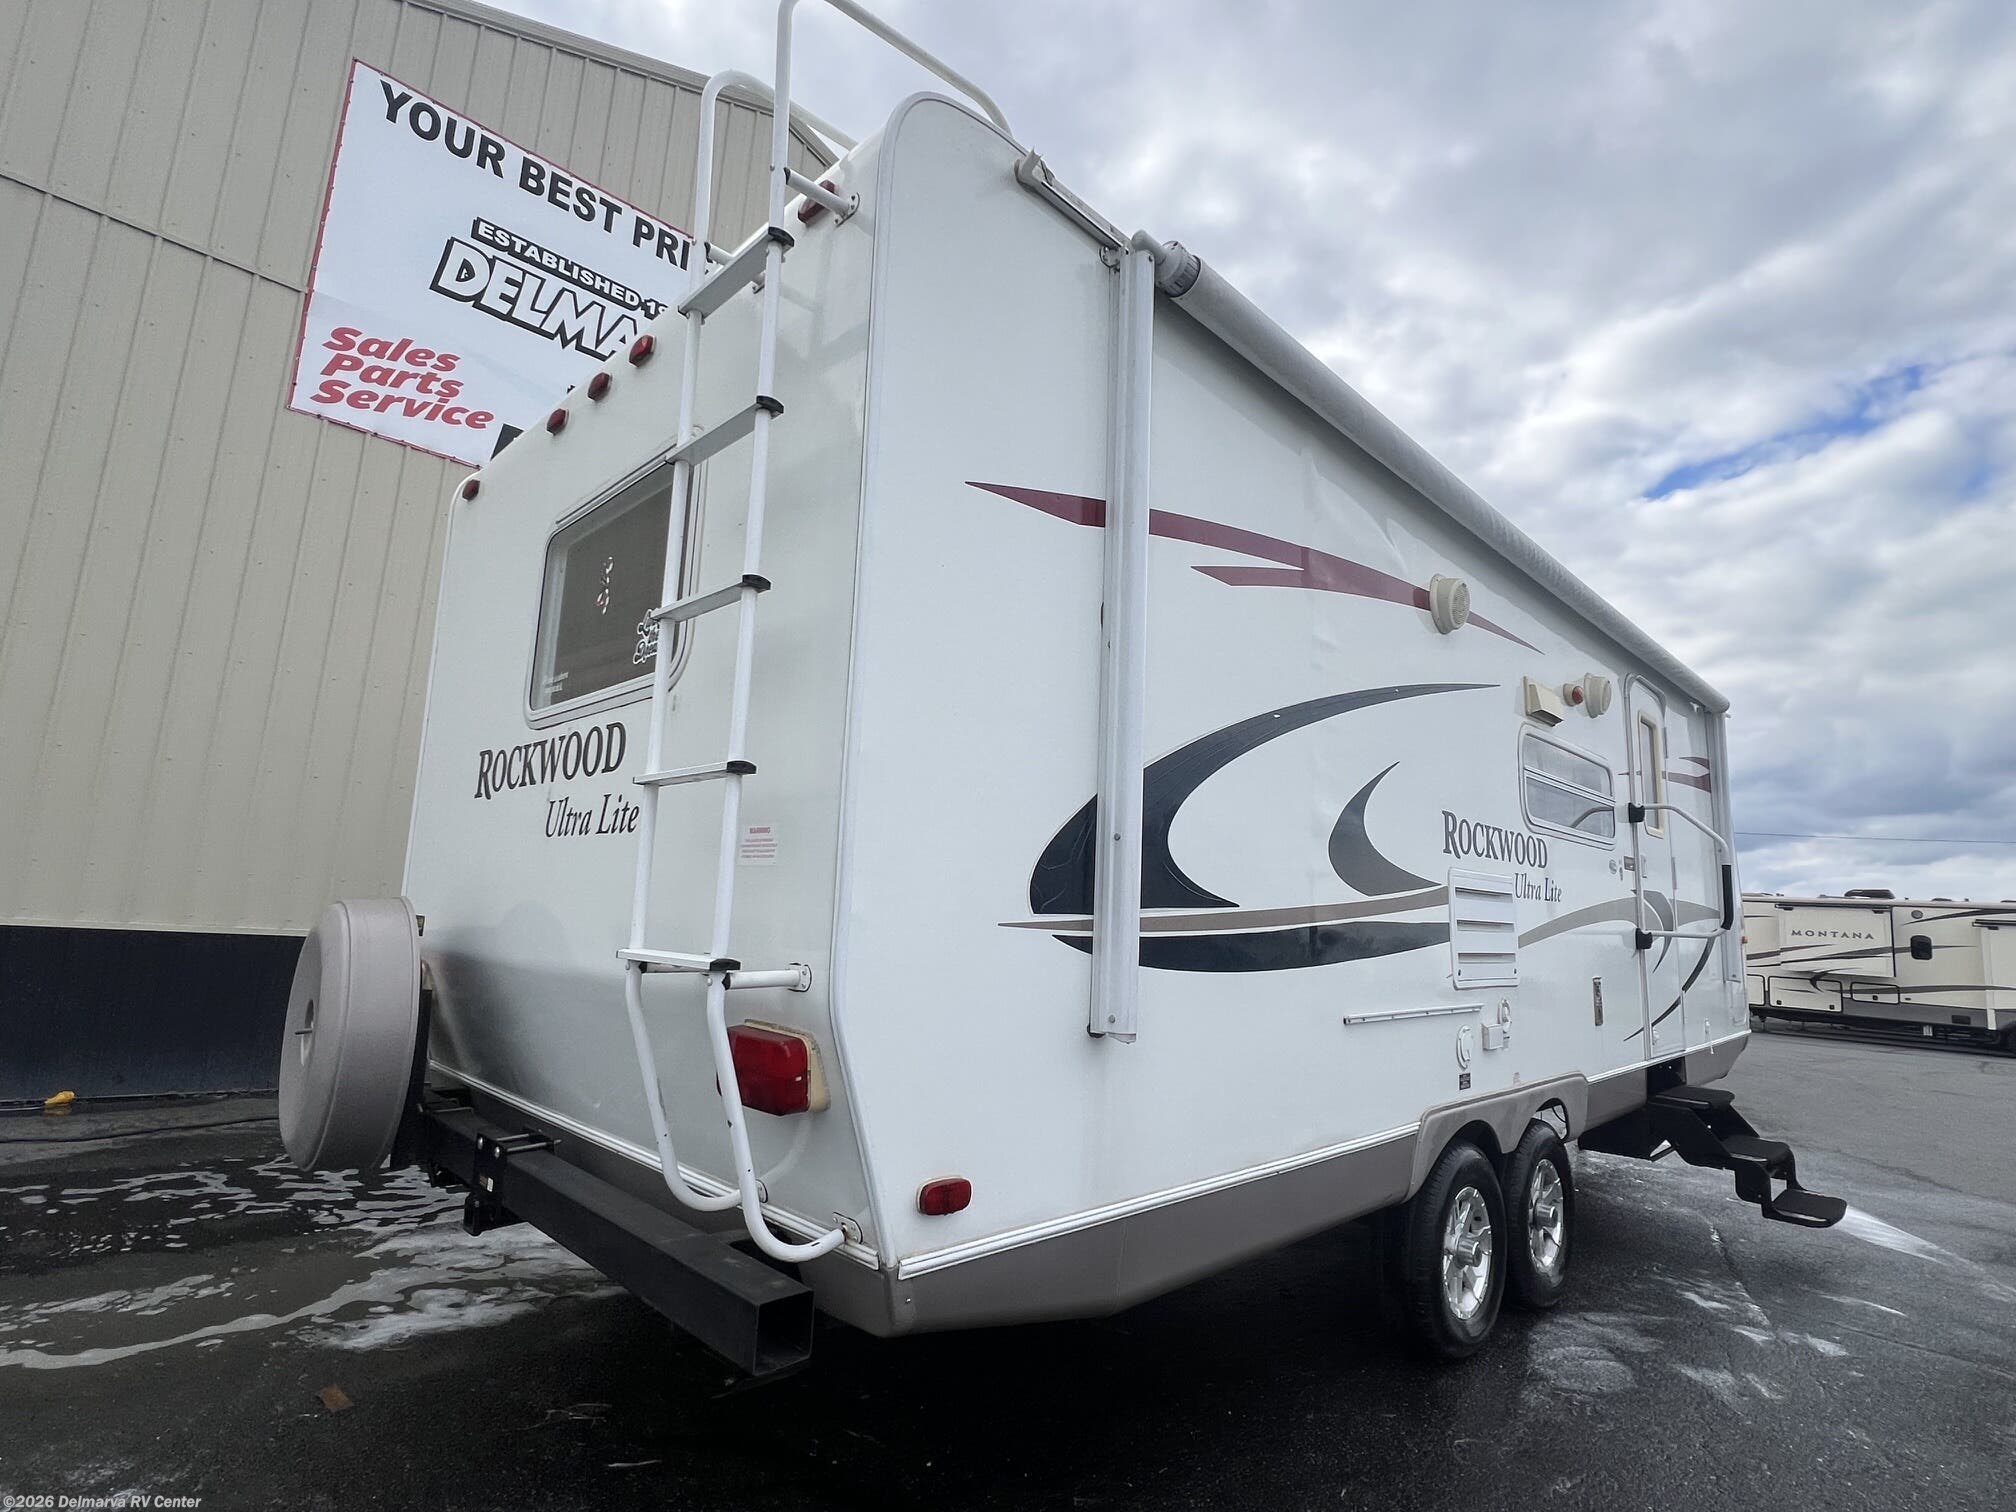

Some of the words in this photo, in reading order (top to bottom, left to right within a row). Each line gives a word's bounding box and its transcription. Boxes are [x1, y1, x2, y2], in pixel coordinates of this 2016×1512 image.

[380, 79, 505, 179] YOUR
[519, 156, 622, 234] BEST
[632, 215, 713, 275] PRI
[477, 219, 641, 307] ESTABLISHED
[322, 326, 461, 372] Sales
[320, 352, 464, 398] Parts
[310, 379, 494, 429] Service
[474, 722, 626, 800] ROCKWOOD
[545, 796, 593, 838] Ultra
[595, 793, 640, 835] Lite
[1442, 810, 1548, 869] ROCKWOOD
[1514, 872, 1542, 901] Ultra
[1544, 877, 1562, 903] Lite
[1791, 929, 1875, 940] MONTANA
